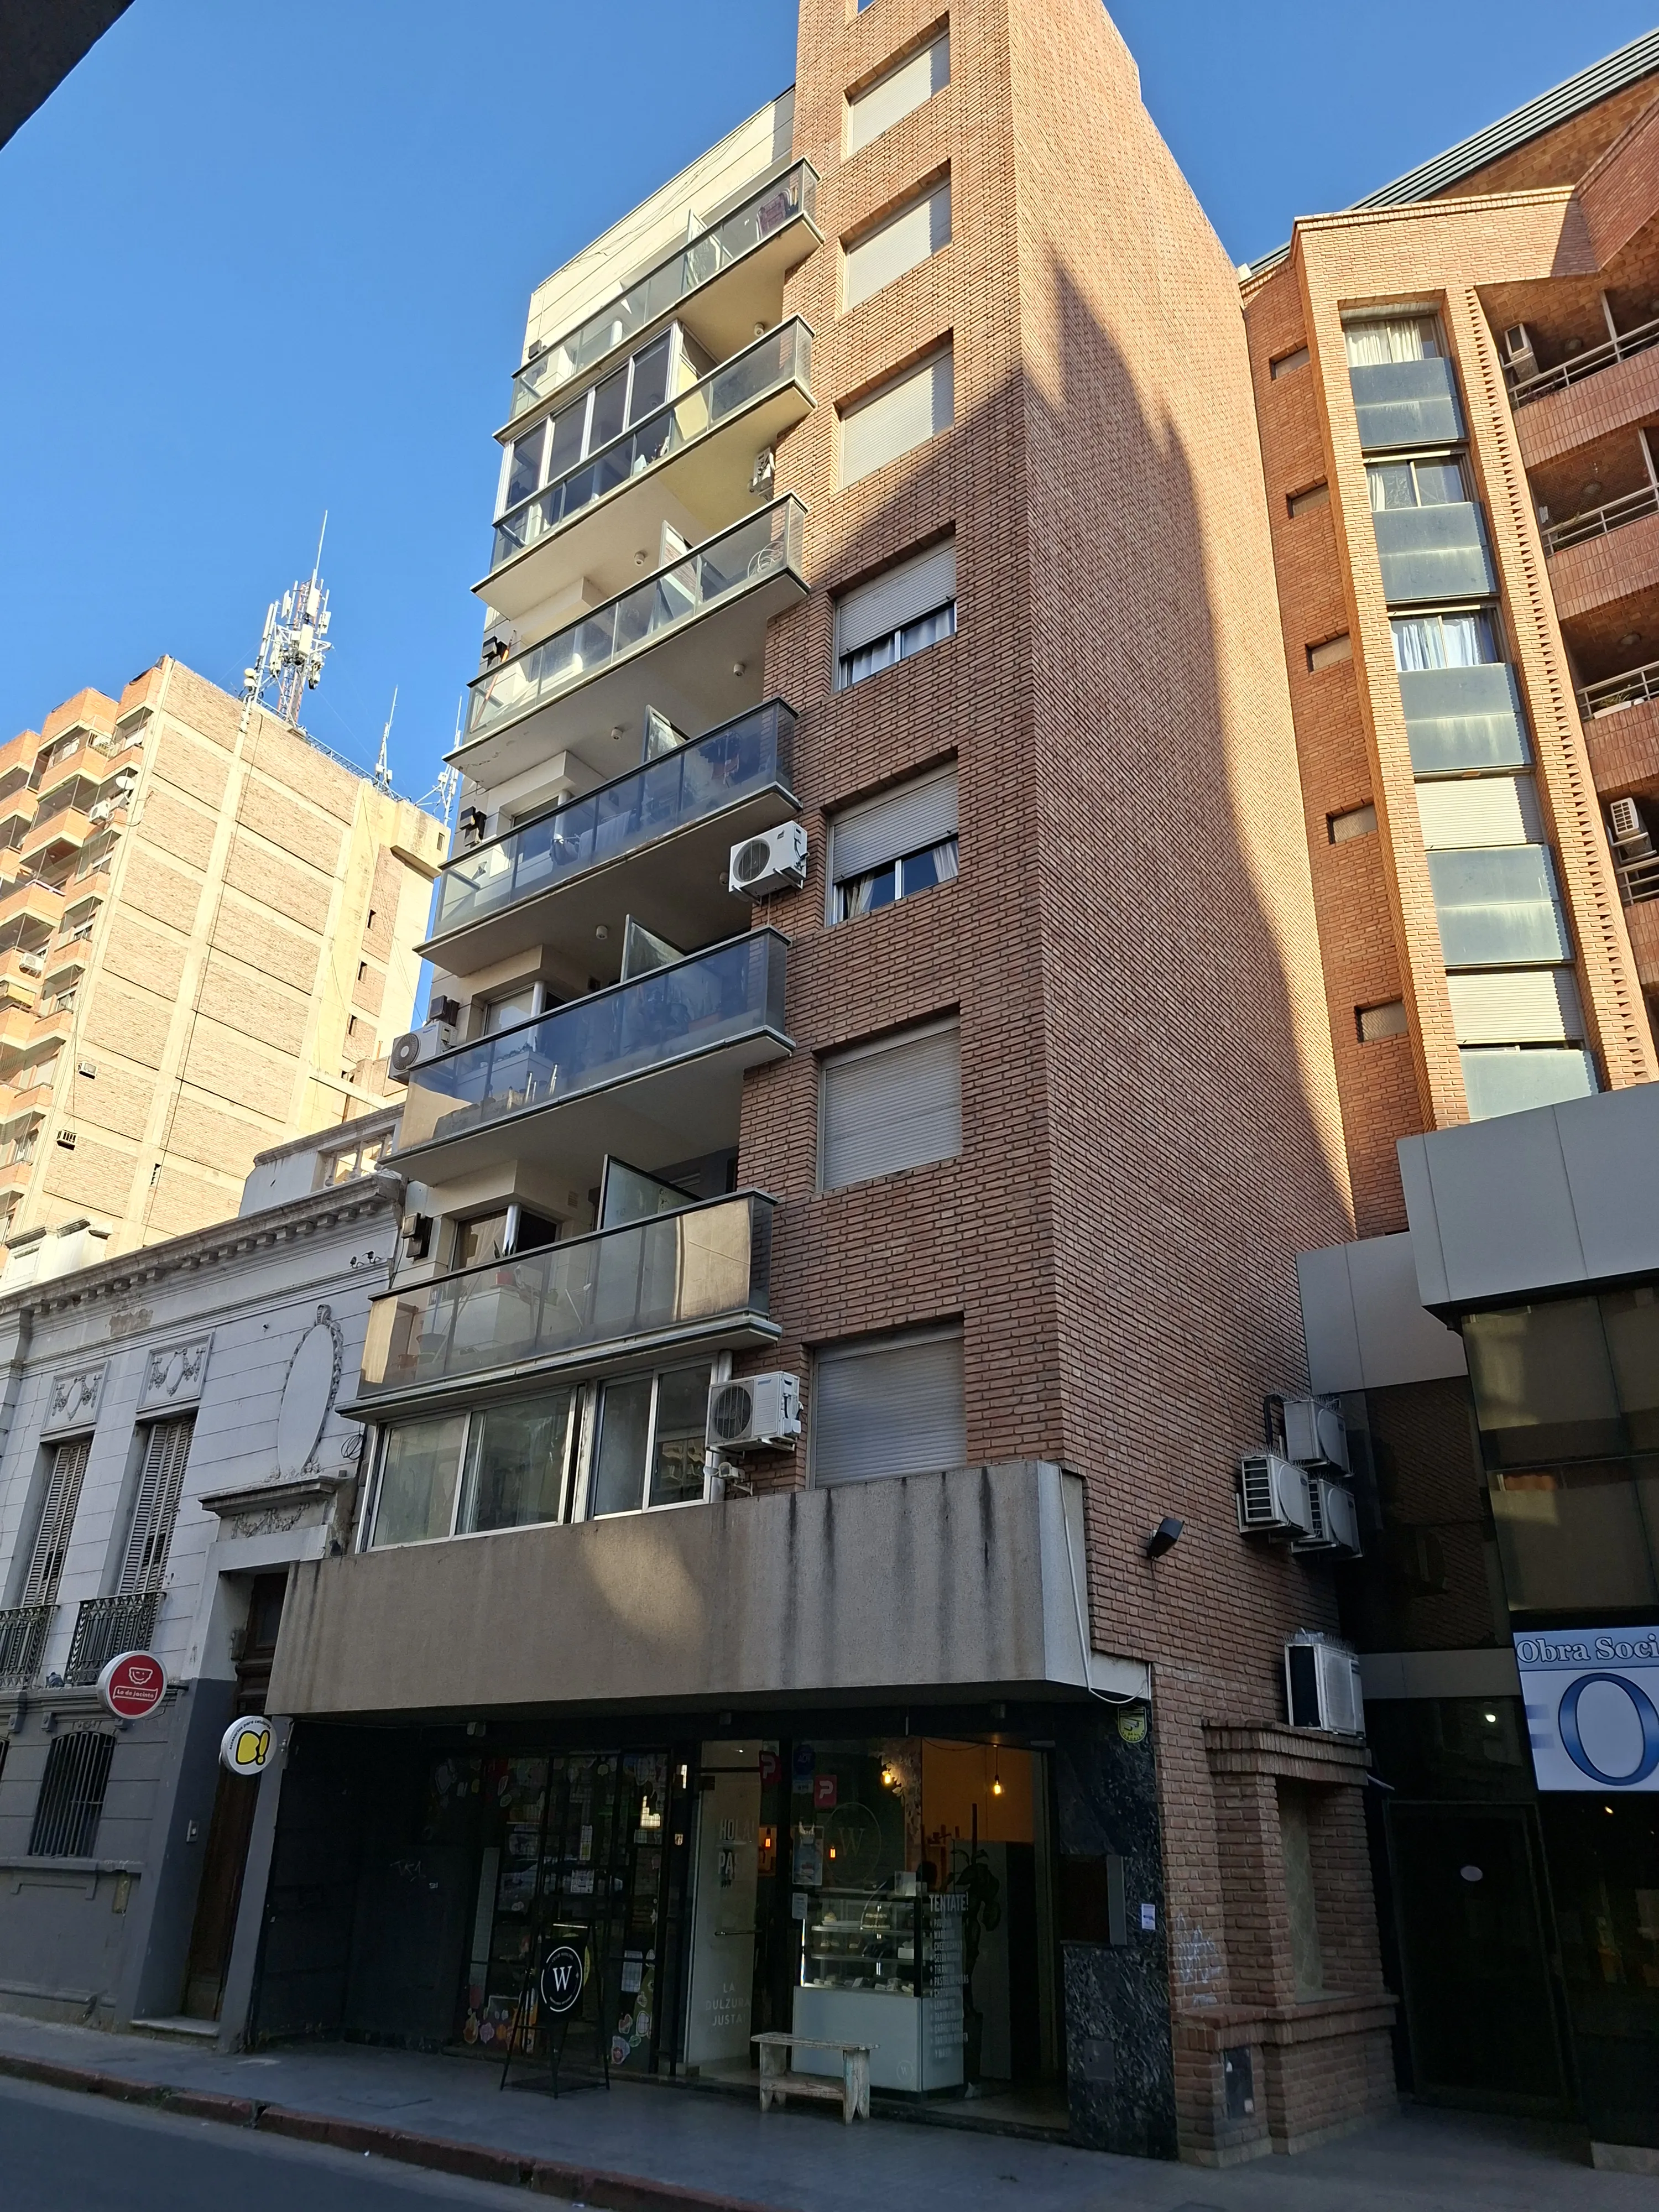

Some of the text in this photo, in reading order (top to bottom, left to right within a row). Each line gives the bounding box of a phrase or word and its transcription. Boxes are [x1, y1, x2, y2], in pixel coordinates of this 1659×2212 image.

[1516, 1637, 1592, 1663] Obra
[243, 1720, 254, 1728] para
[838, 1827, 866, 1857] W
[929, 1891, 969, 1912] TENTATE!
[552, 1965, 573, 1992] W
[723, 1981, 735, 1993] LA
[705, 1997, 751, 2011] DULZURA
